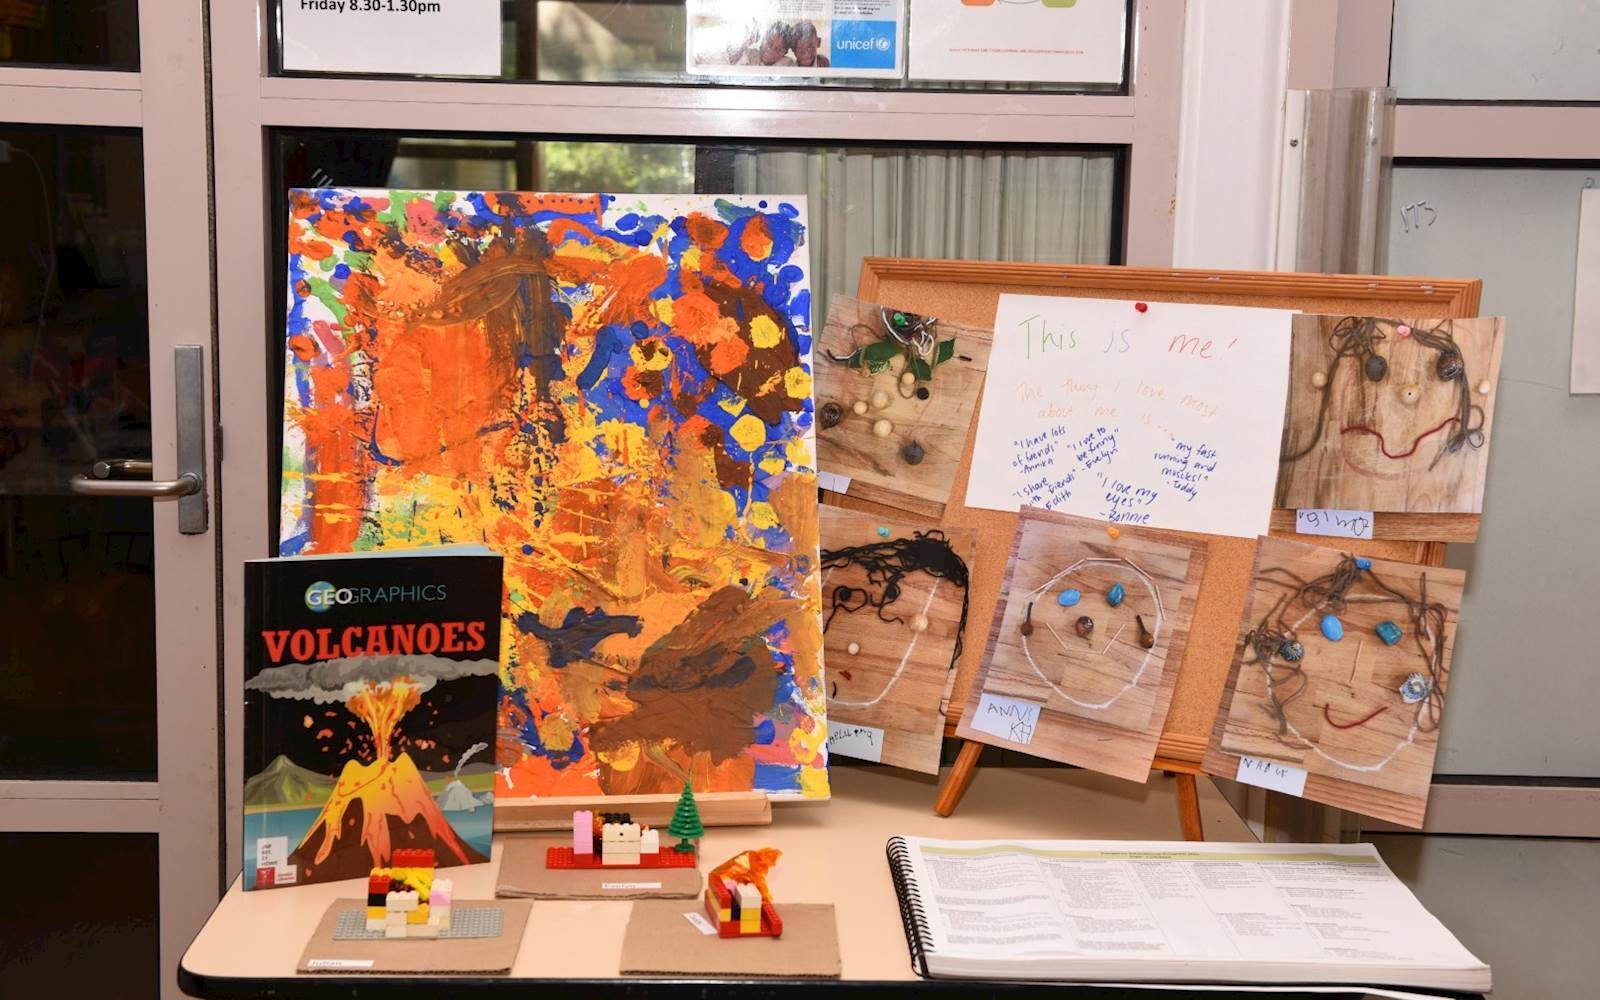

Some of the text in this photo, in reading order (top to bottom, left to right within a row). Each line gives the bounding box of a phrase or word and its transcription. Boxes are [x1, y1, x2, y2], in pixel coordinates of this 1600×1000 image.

[300, 0, 441, 14] Friday 8.30-1.30pm
[836, 38, 876, 50] unicef
[1018, 314, 1078, 361] This
[1104, 328, 1134, 354] is
[1017, 381, 1043, 401] The
[1060, 376, 1098, 400] thing
[1136, 380, 1168, 400] love
[1180, 394, 1220, 418] most
[1038, 402, 1074, 419] about
[1094, 406, 1119, 418] me
[1025, 431, 1048, 449] have
[1051, 424, 1068, 438] lots
[1078, 432, 1096, 448] love
[1096, 427, 1107, 437] to
[1075, 450, 1088, 462] be
[1196, 443, 1217, 459] fast
[1153, 452, 1218, 472] running and
[1023, 476, 1049, 496] share
[1111, 479, 1132, 496] love
[1135, 487, 1159, 506] my
[262, 620, 487, 663] VOLCANOES
